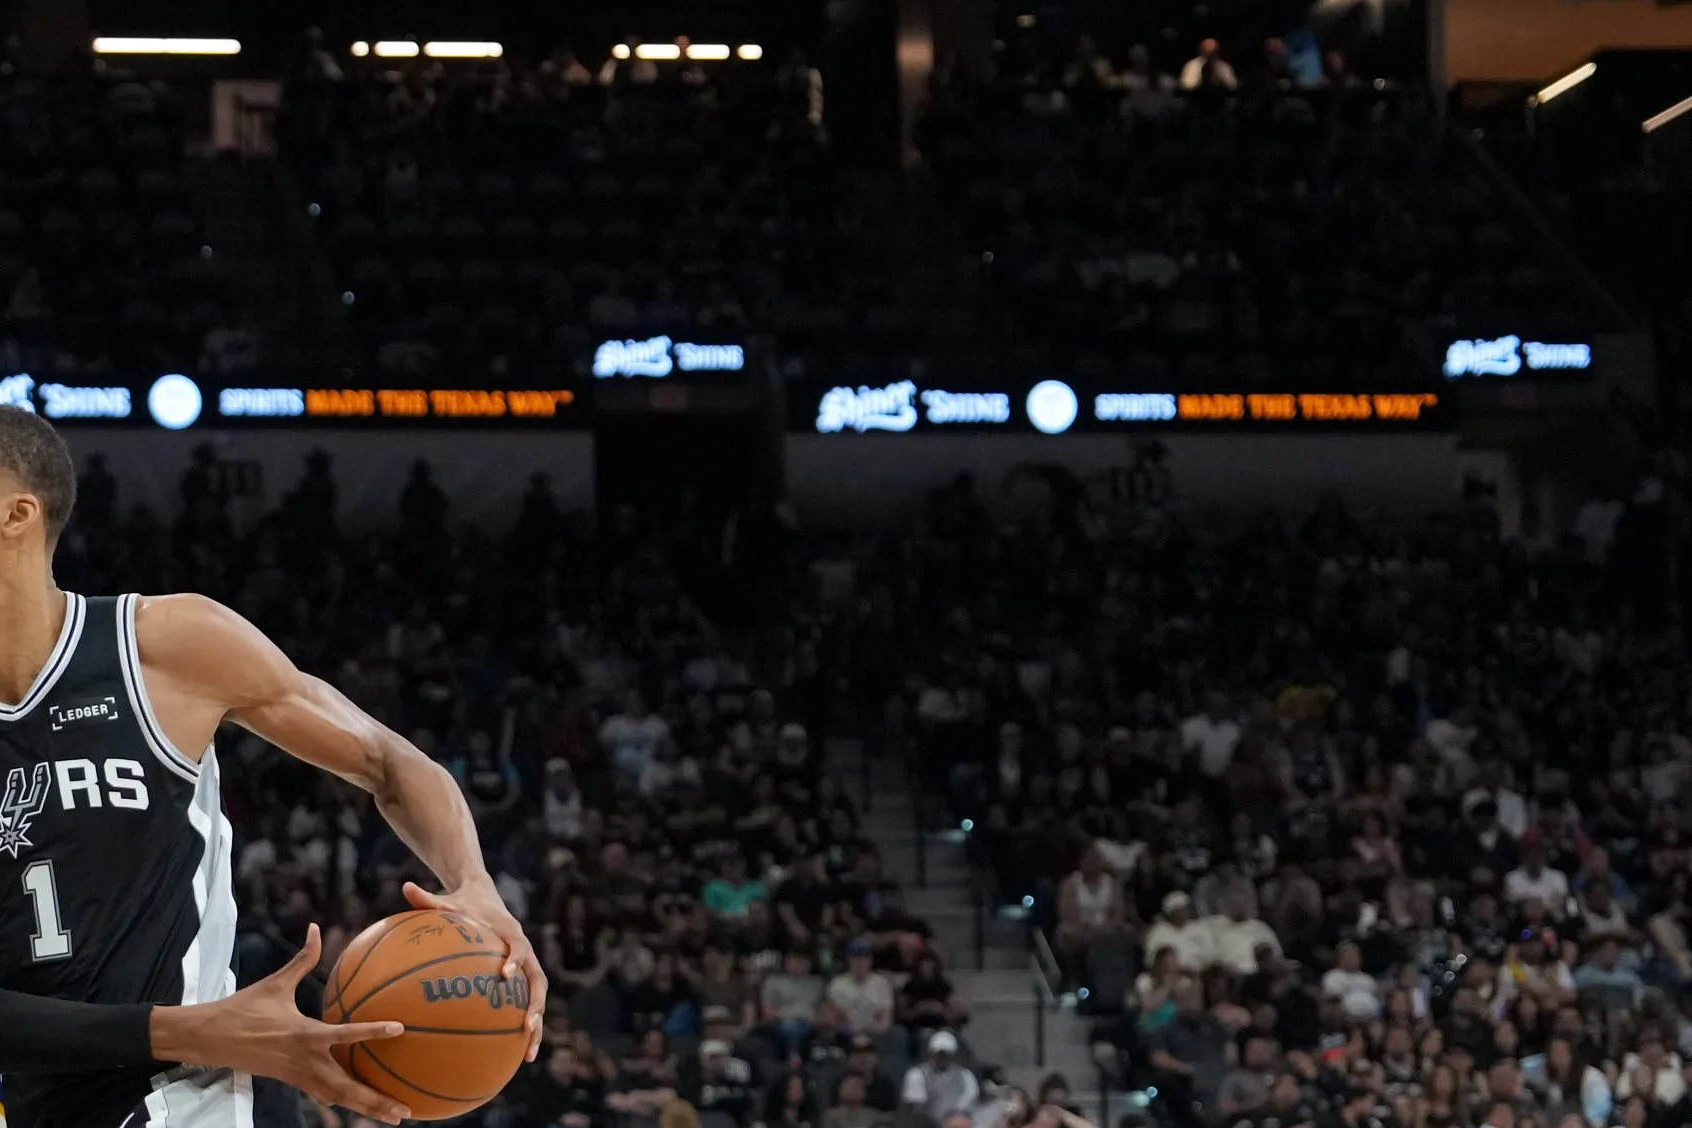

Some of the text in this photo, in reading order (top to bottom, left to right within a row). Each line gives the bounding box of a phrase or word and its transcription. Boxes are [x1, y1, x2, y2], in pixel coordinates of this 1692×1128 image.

[377, 390, 427, 413] THE
[430, 391, 506, 414] TEXAS
[1248, 395, 1295, 417] THE
[1299, 395, 1371, 417] TEXAS
[58, 704, 109, 722] LEDGER
[21, 859, 72, 962] 1
